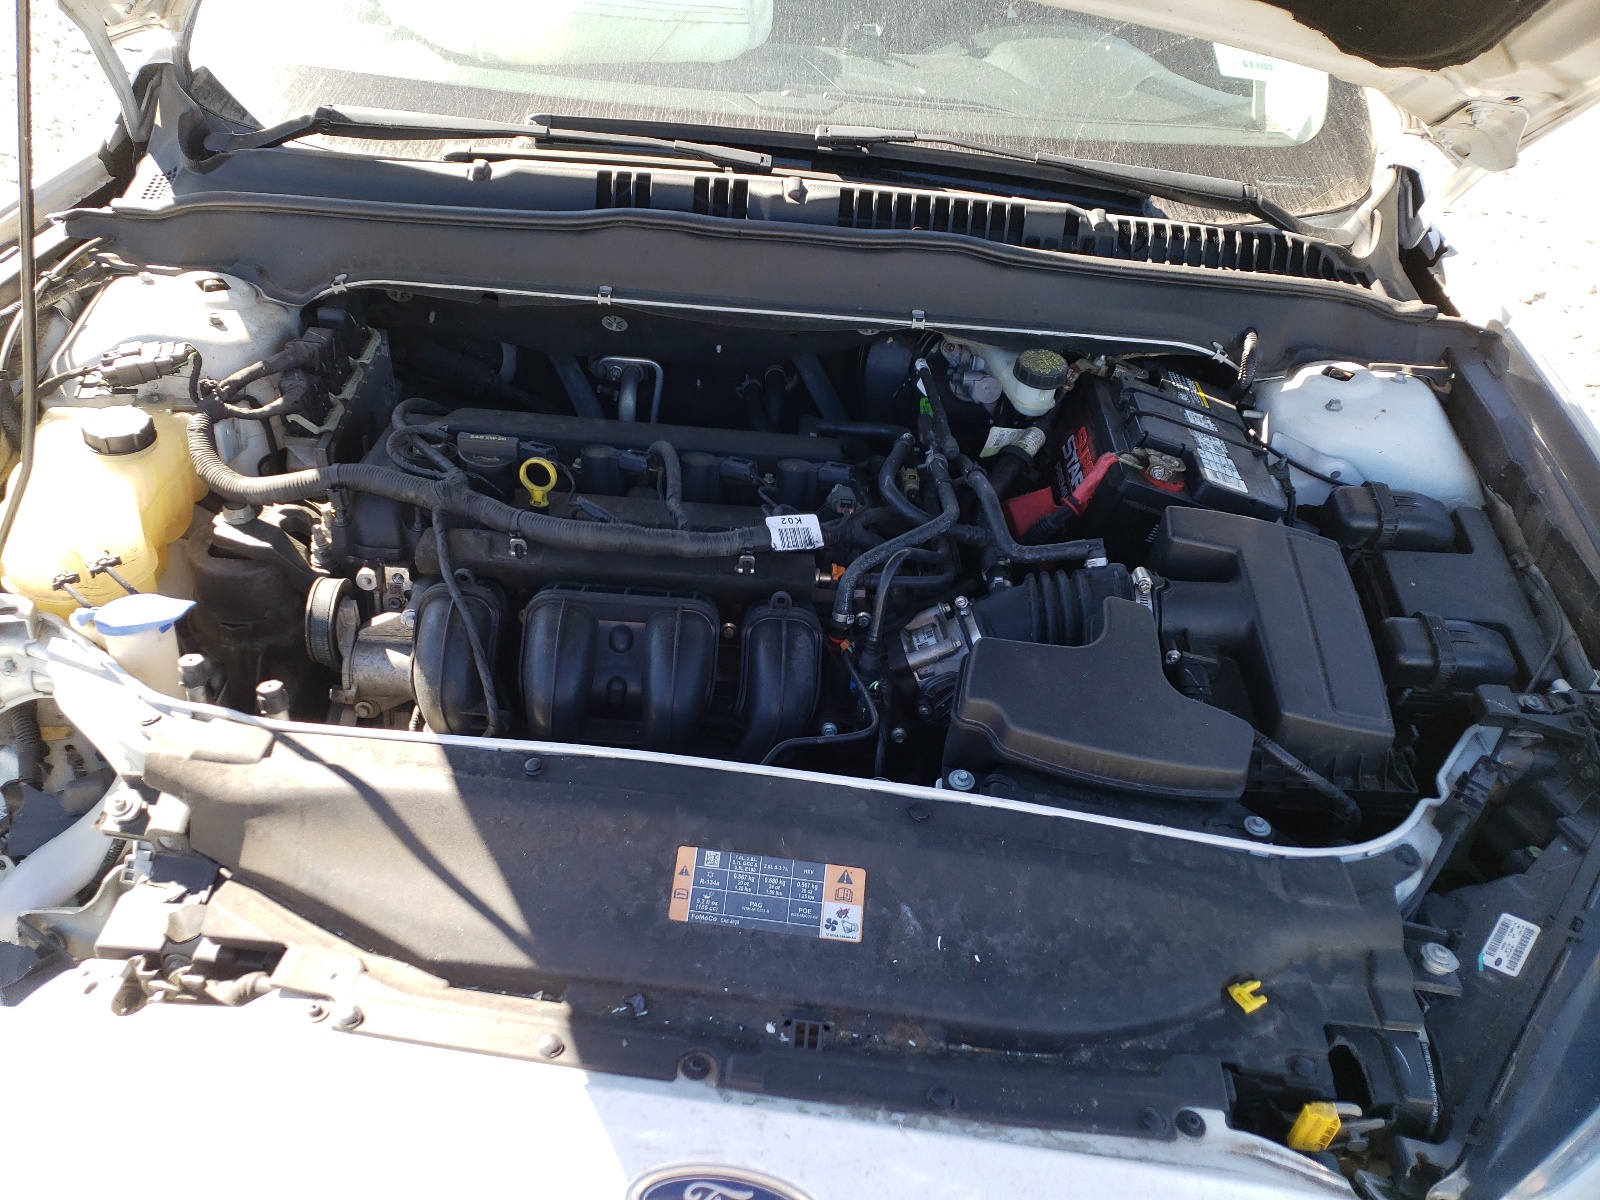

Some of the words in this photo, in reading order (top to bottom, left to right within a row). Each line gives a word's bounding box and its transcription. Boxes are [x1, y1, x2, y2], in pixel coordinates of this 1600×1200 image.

[1074, 426, 1095, 479] SUPE
[1062, 434, 1084, 489] STAR
[781, 517, 802, 525] K02
[748, 875, 755, 883] kg
[780, 879, 786, 887] kg
[811, 883, 818, 891] kg
[691, 913, 718, 922] FoMoCo
